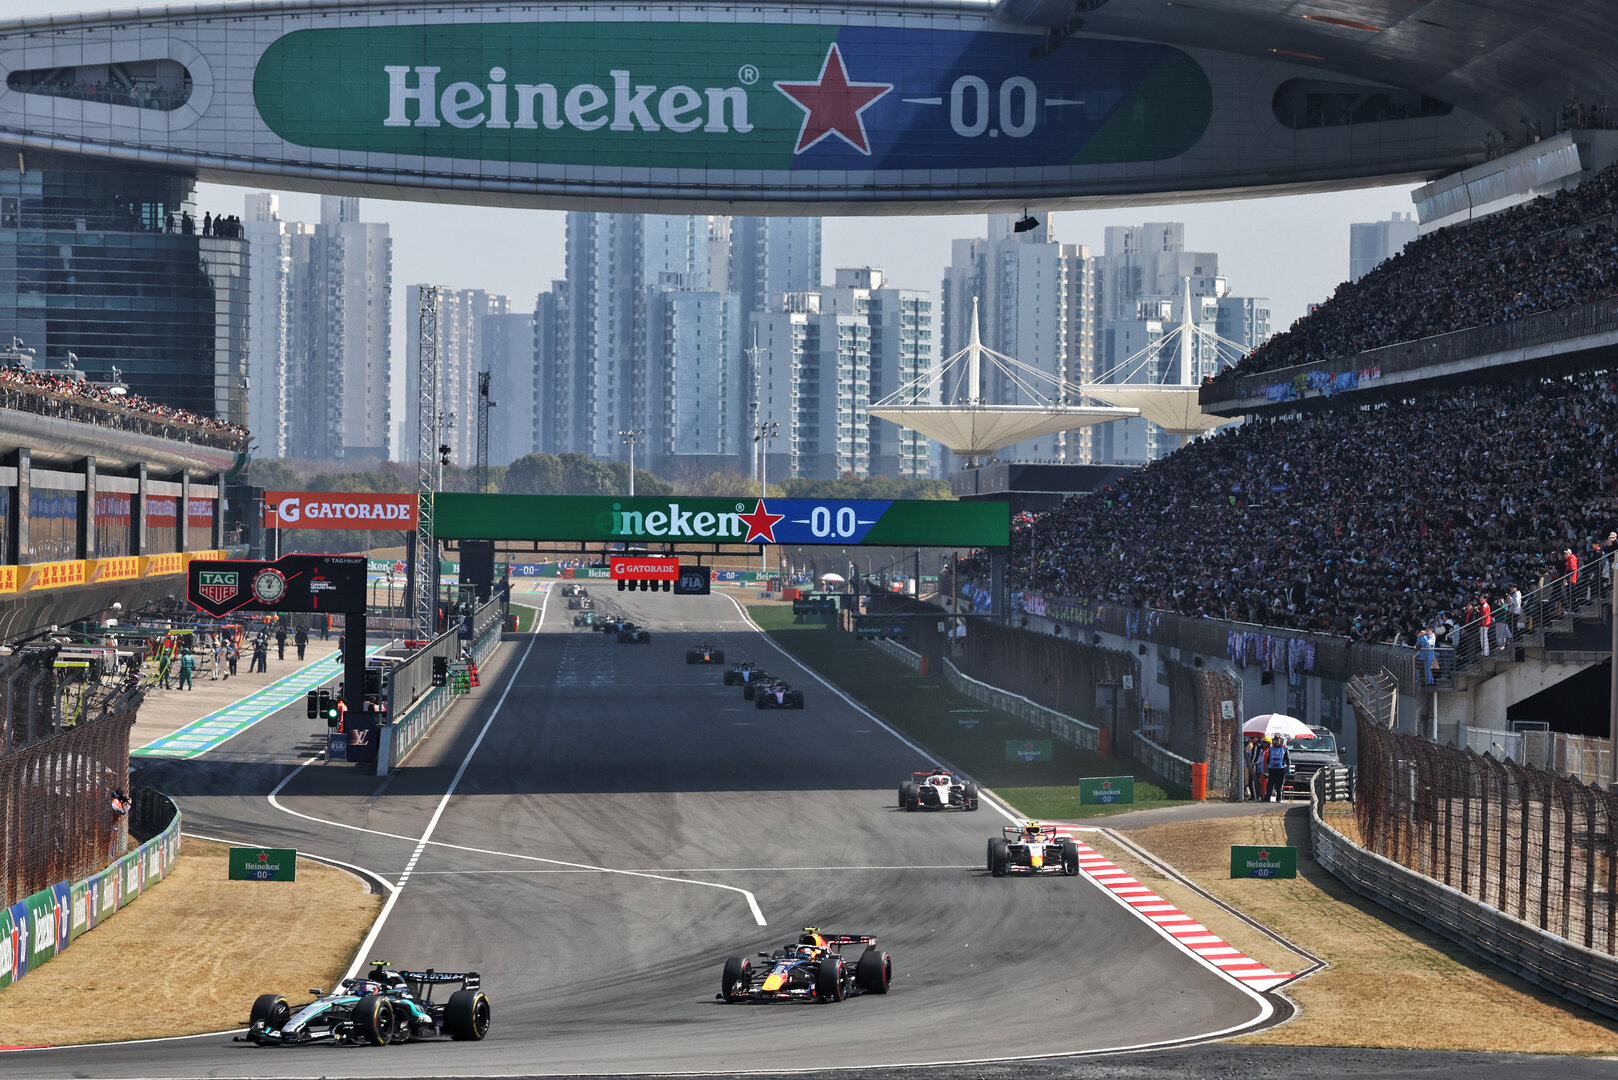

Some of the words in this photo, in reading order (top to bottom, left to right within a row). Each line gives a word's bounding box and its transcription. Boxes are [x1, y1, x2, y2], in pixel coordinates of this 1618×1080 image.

[951, 75, 1037, 138] 0.0
[305, 502, 410, 520] GATORADE
[811, 506, 856, 537] 0.0
[626, 565, 674, 573] GATORADE
[203, 574, 235, 584] TAG
[201, 585, 236, 601] HEUER
[245, 862, 280, 871] Heineken
[1246, 860, 1281, 868] Heineken
